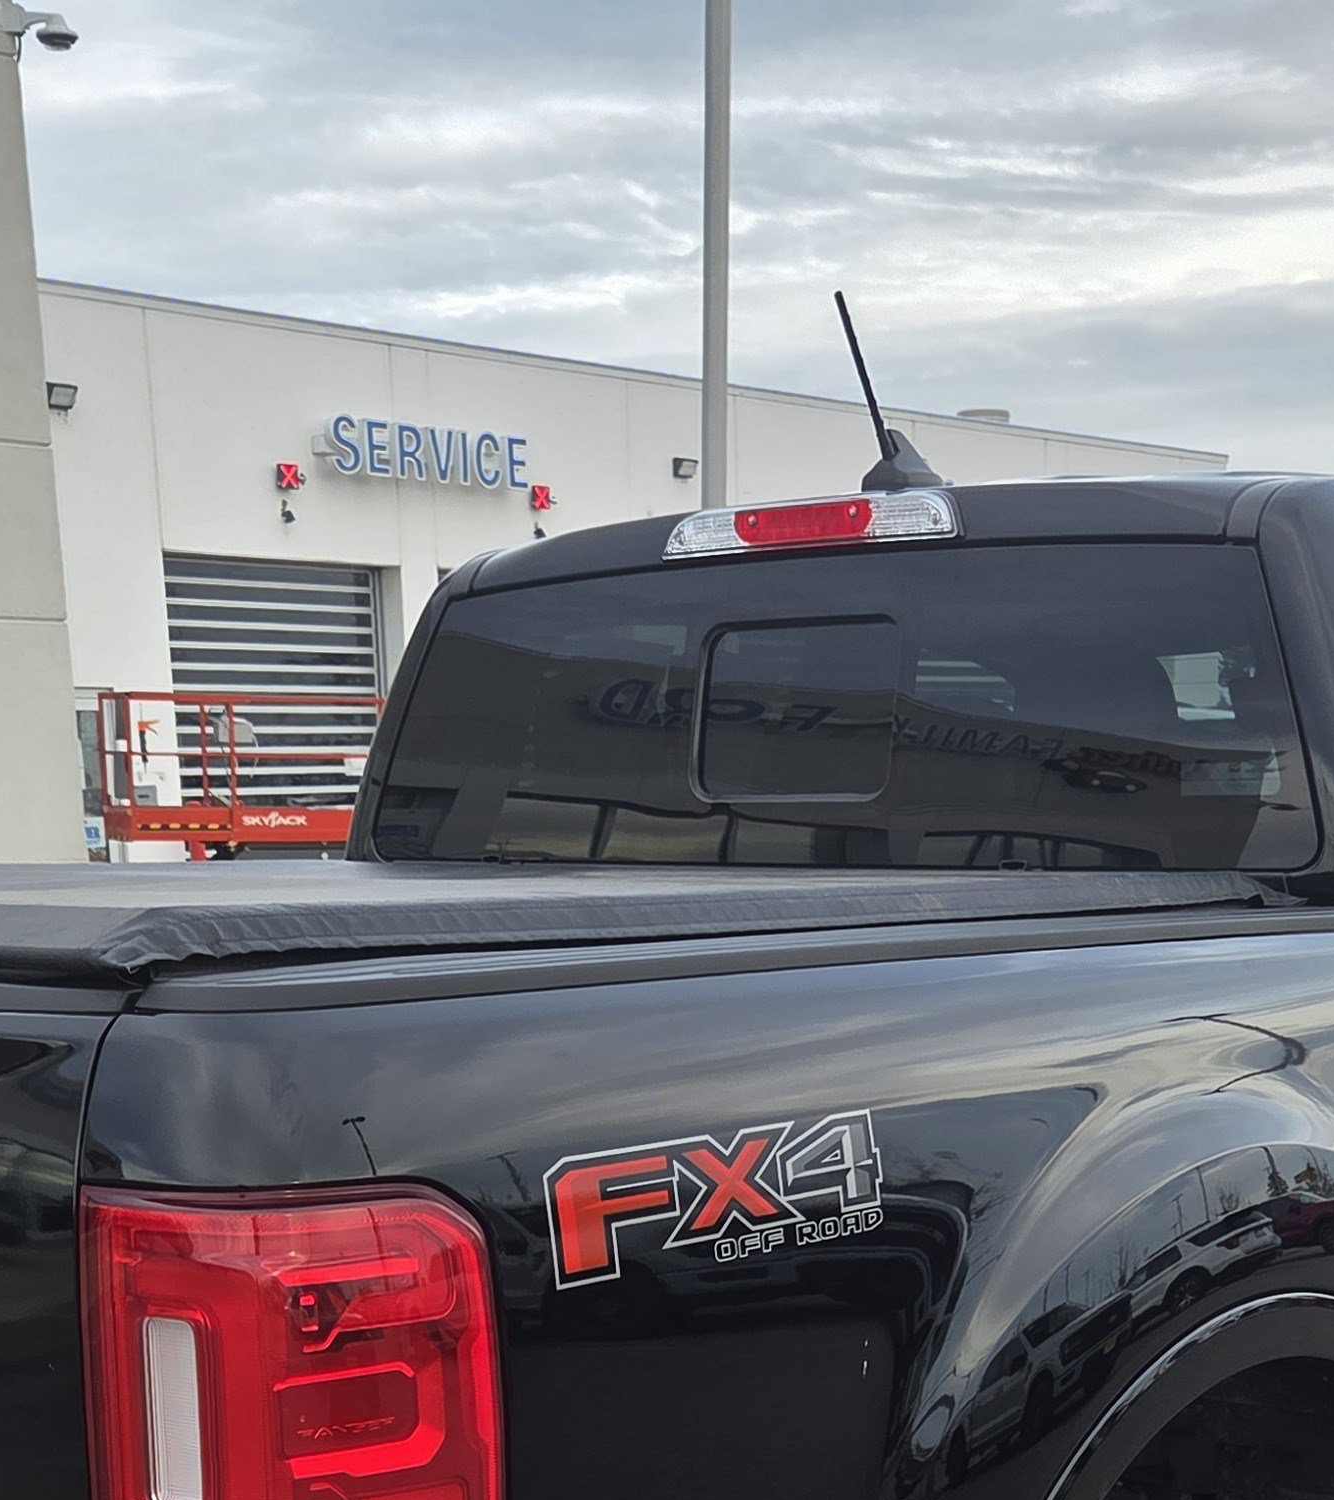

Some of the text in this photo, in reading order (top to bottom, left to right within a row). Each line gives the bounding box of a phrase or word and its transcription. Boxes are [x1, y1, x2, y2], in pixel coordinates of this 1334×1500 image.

[331, 413, 529, 490] SERVICE
[241, 811, 308, 828] SKYJACK
[543, 1109, 884, 1289] FX4
[714, 1208, 884, 1263] OFF ROAD
